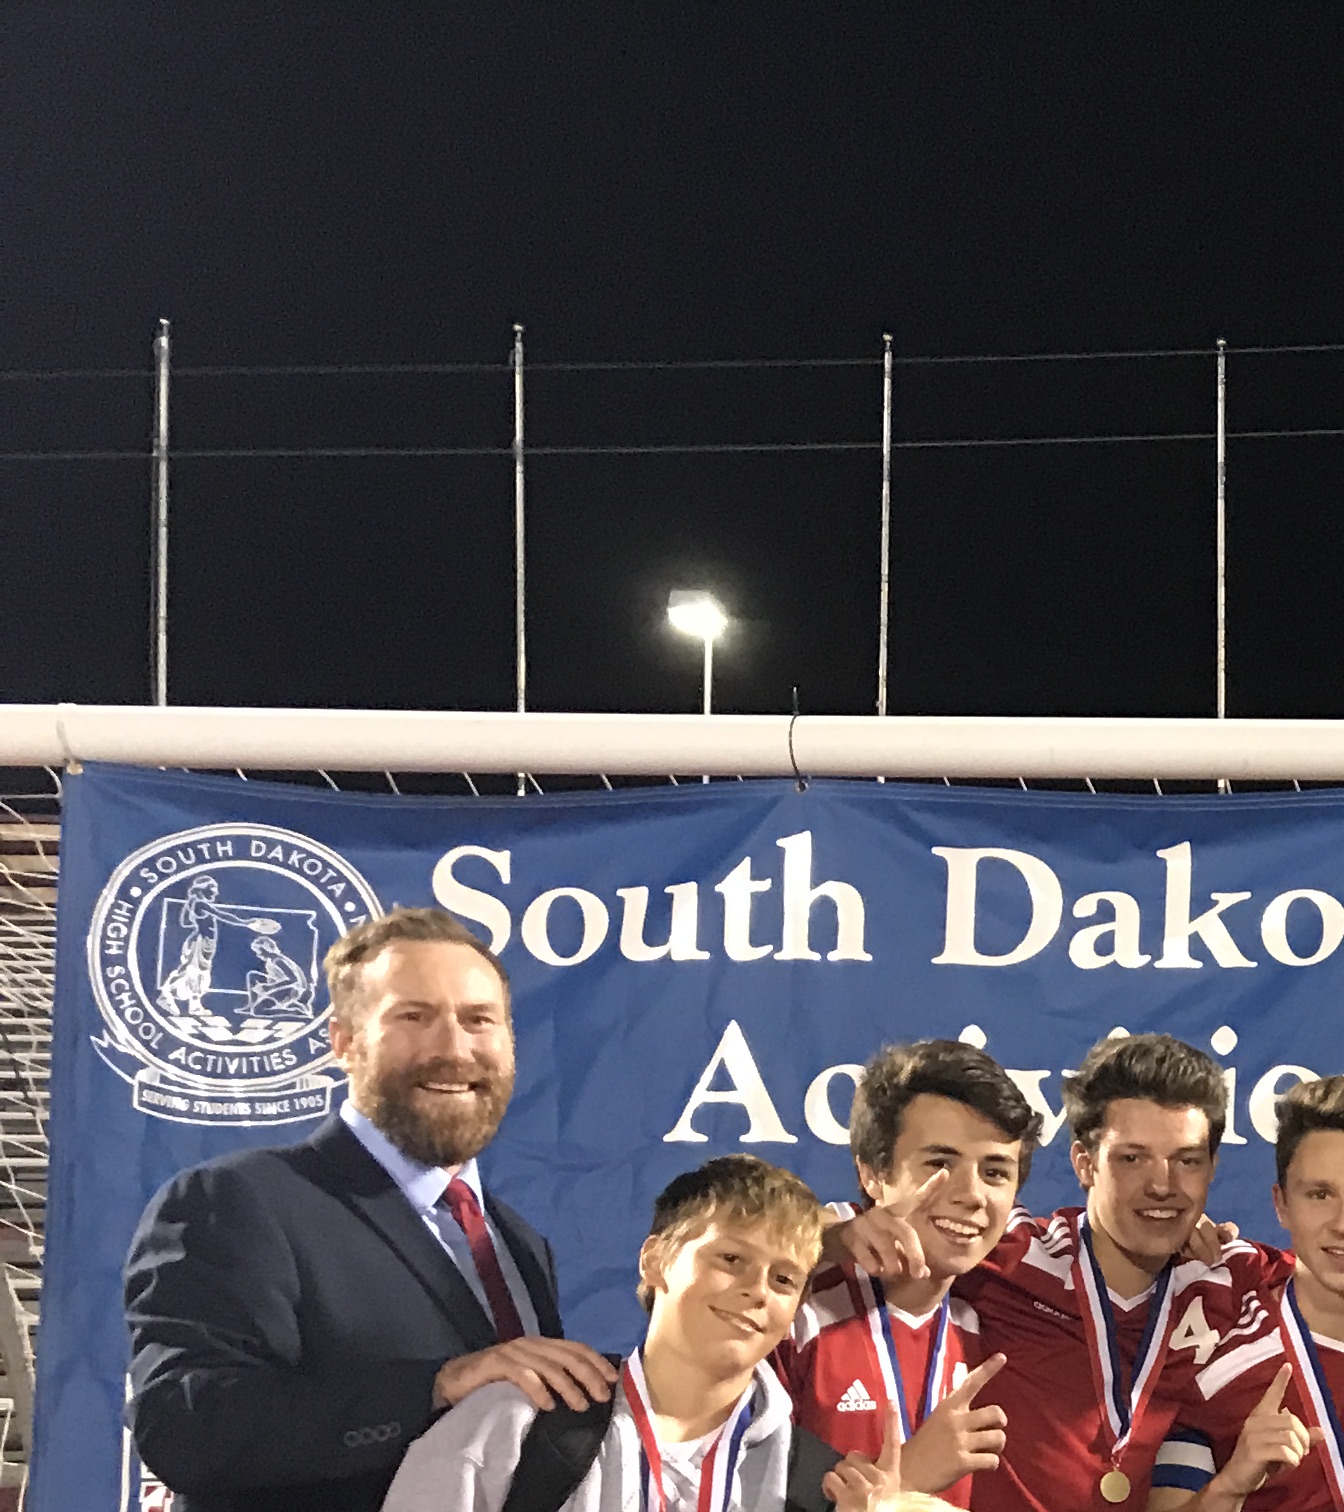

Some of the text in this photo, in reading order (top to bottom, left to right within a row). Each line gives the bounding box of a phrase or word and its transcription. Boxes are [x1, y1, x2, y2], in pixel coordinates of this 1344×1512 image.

[140, 839, 348, 899] SOUTH DAKOTA
[431, 830, 874, 967] South
[105, 899, 298, 1075] HIGH SCHOOL ACTIVITIES
[142, 1090, 324, 1116] SERVING STUDENTS SINCE 1905
[1168, 1295, 1221, 1365] 4
[836, 1398, 877, 1413] adidas
